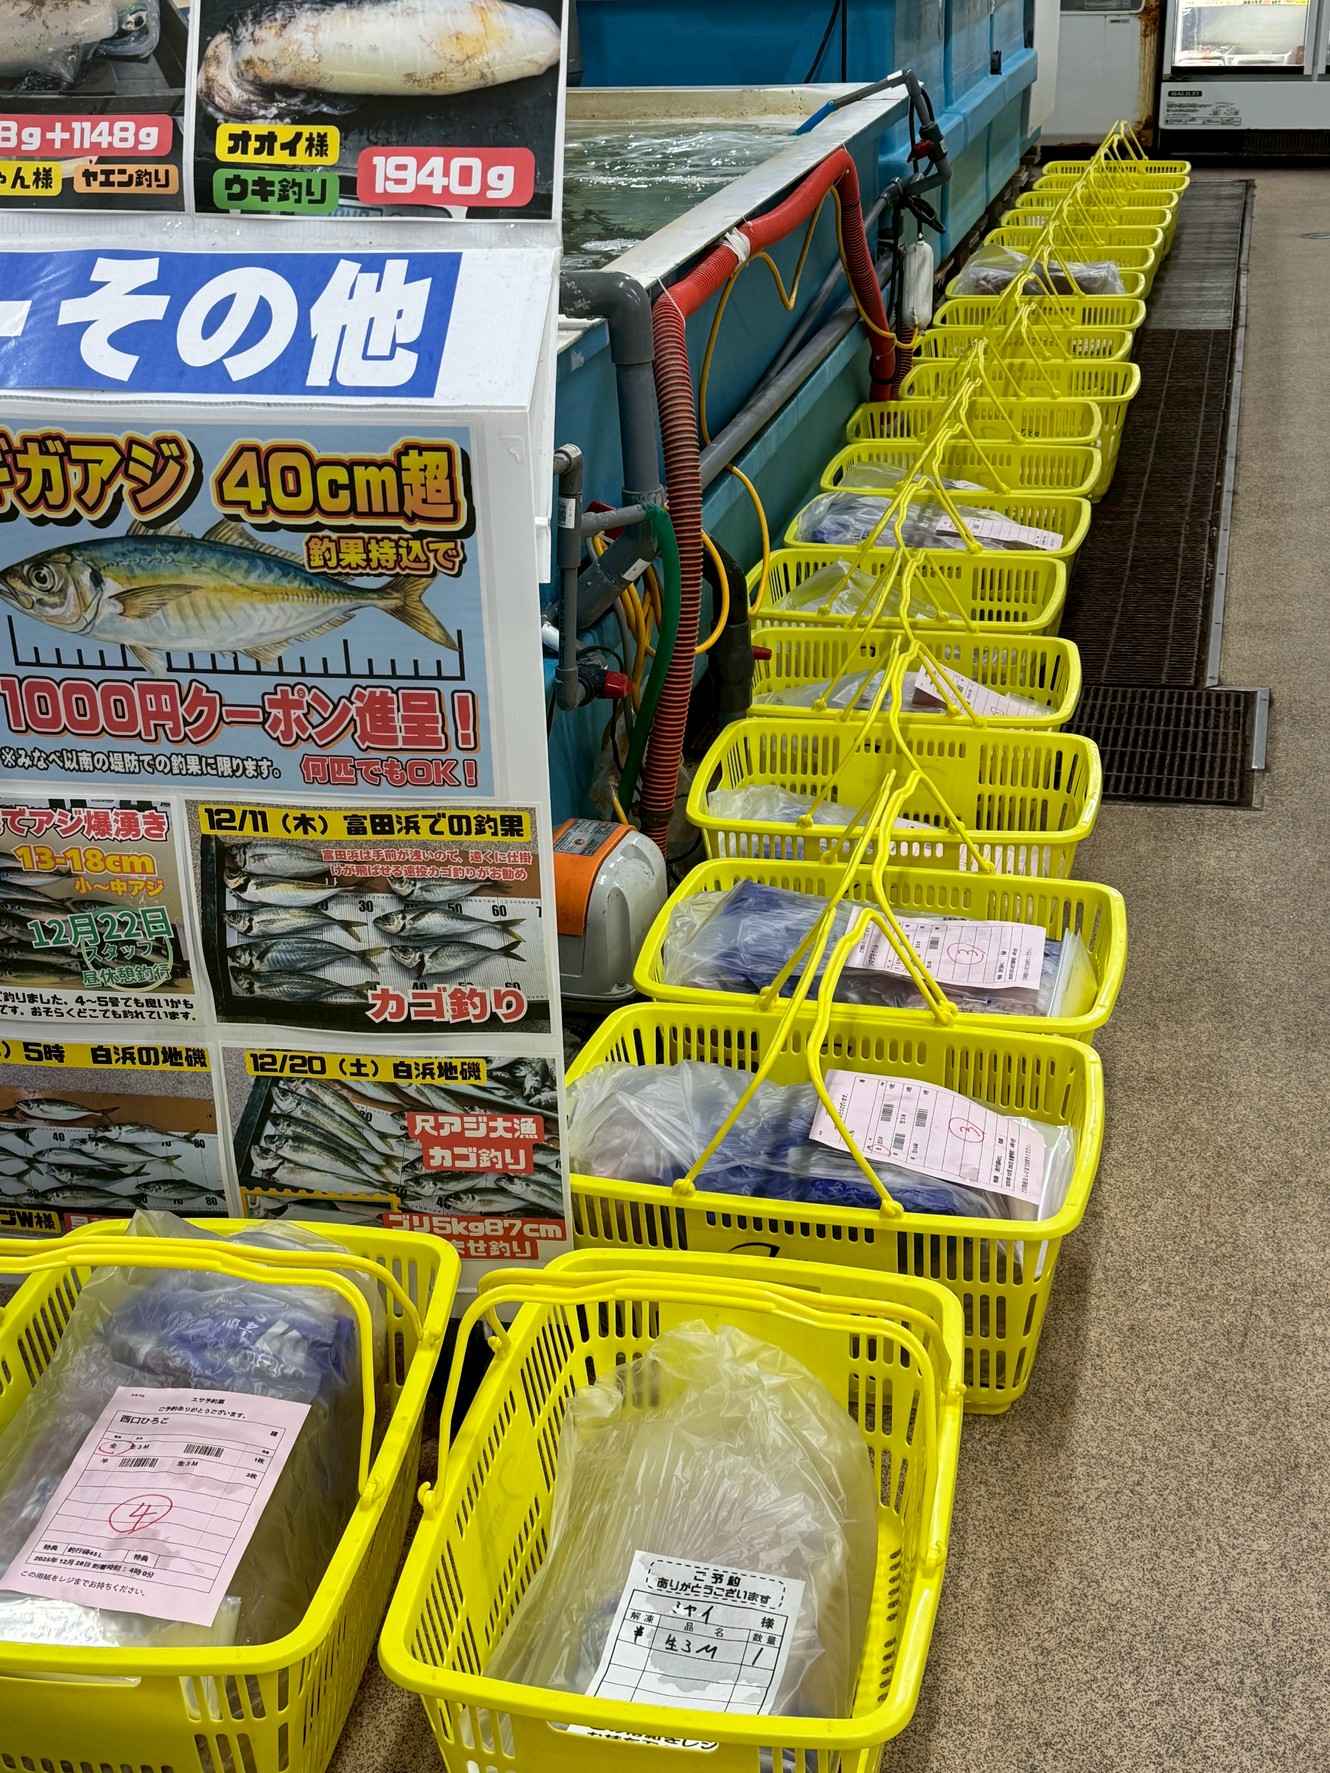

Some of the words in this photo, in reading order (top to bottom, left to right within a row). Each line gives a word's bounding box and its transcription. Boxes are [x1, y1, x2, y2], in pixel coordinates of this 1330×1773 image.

[227, 130, 329, 159] オオイ様
[82, 168, 170, 188] ヤエン釣り
[224, 174, 328, 204] ウキ釣り
[372, 156, 516, 199] 1940g
[215, 445, 462, 524] 40cm超
[307, 534, 464, 576] 釣果持込で
[0, 677, 477, 752] 1000円クーポン進呈！
[302, 756, 478, 788] 何匹でもOK！
[14, 845, 157, 876] 13-18cm
[27, 906, 175, 949] 12月22日
[86, 941, 155, 962] スタッフ
[82, 963, 173, 988] 昼休憩釣行
[0, 992, 194, 1009] 釣りました。4～5号でも良いかも
[366, 985, 528, 1023] カゴ釣り
[90, 1045, 208, 1067] 白浜の地磯
[415, 1115, 539, 1139] 尺アジ大漁
[429, 1146, 527, 1170] カゴ釣り
[20, 1570, 146, 1597] この用紙をレジまでお持ちください。
[656, 1577, 772, 1605] ありがとうございます
[761, 1616, 776, 1629] 様
